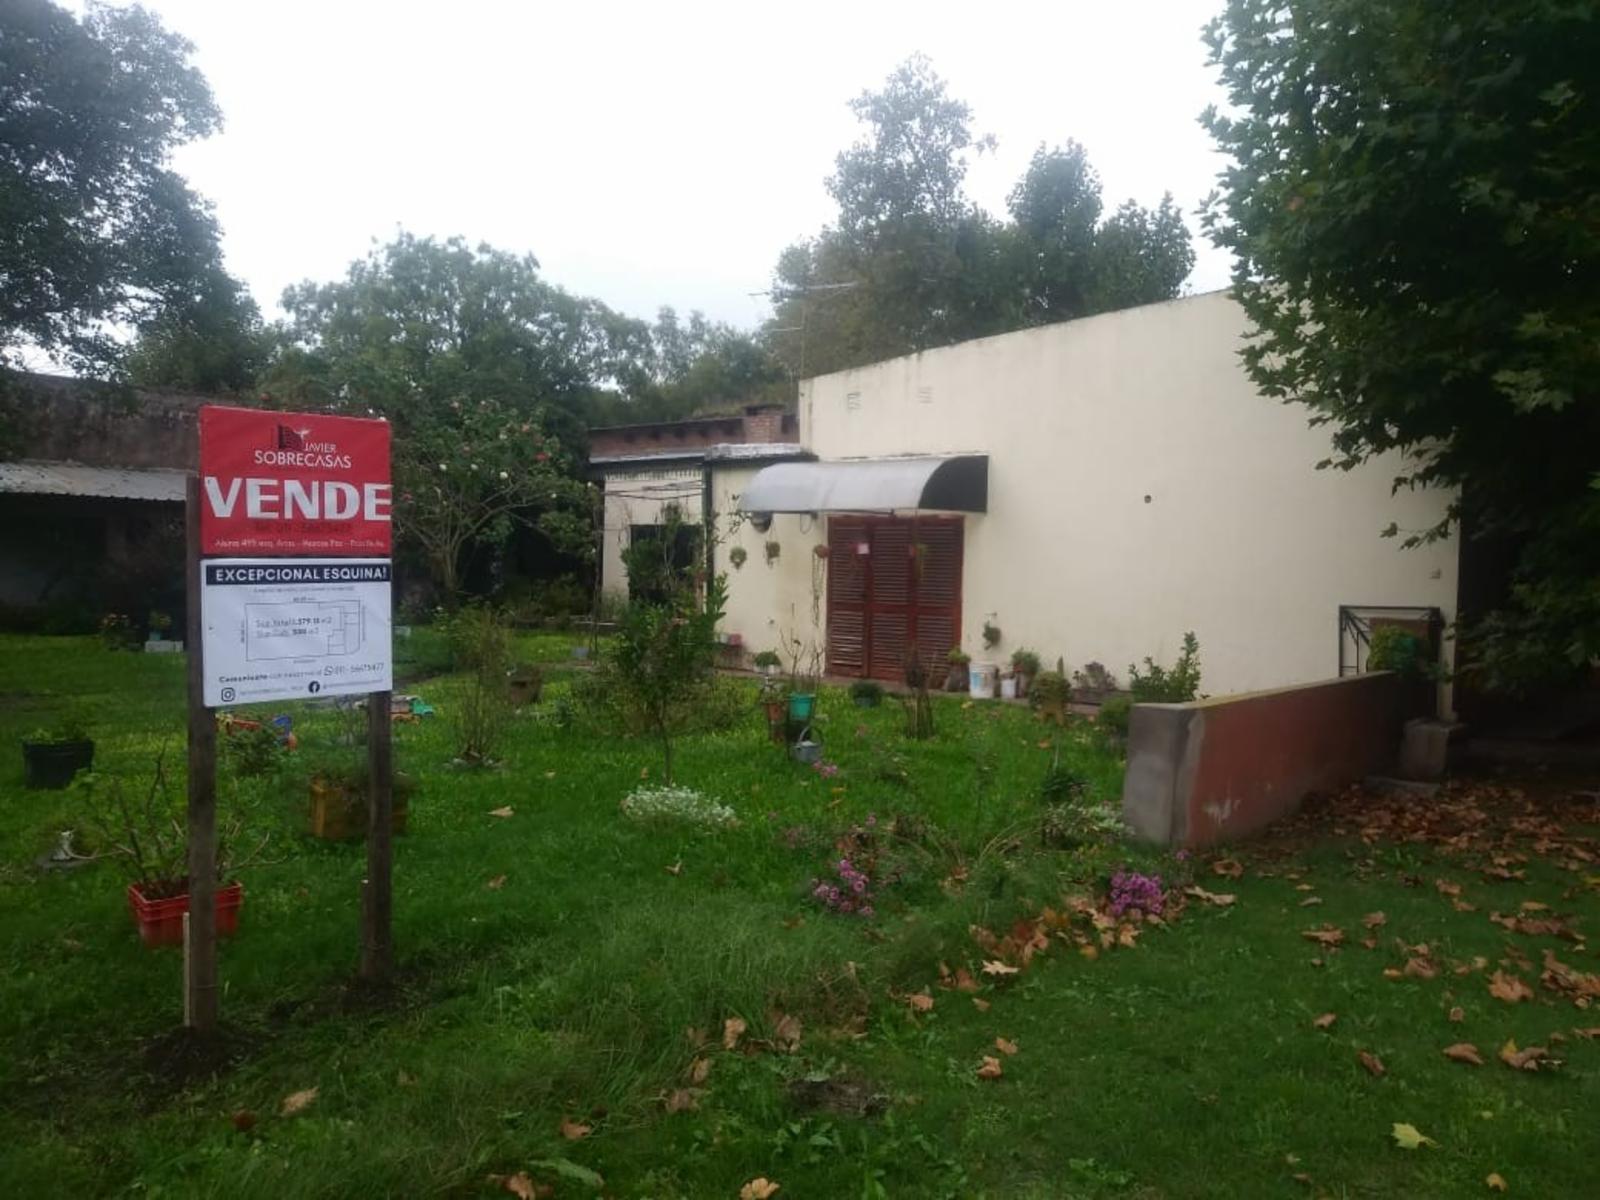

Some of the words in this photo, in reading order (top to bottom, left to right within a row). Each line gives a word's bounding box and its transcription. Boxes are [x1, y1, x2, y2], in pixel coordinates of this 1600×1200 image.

[305, 443, 337, 453] JAVIER
[254, 450, 352, 469] SOBRECASAS
[204, 476, 393, 521] VENDE
[216, 568, 320, 581] EXCEPCIONAL
[324, 566, 387, 580] ESQUINA!
